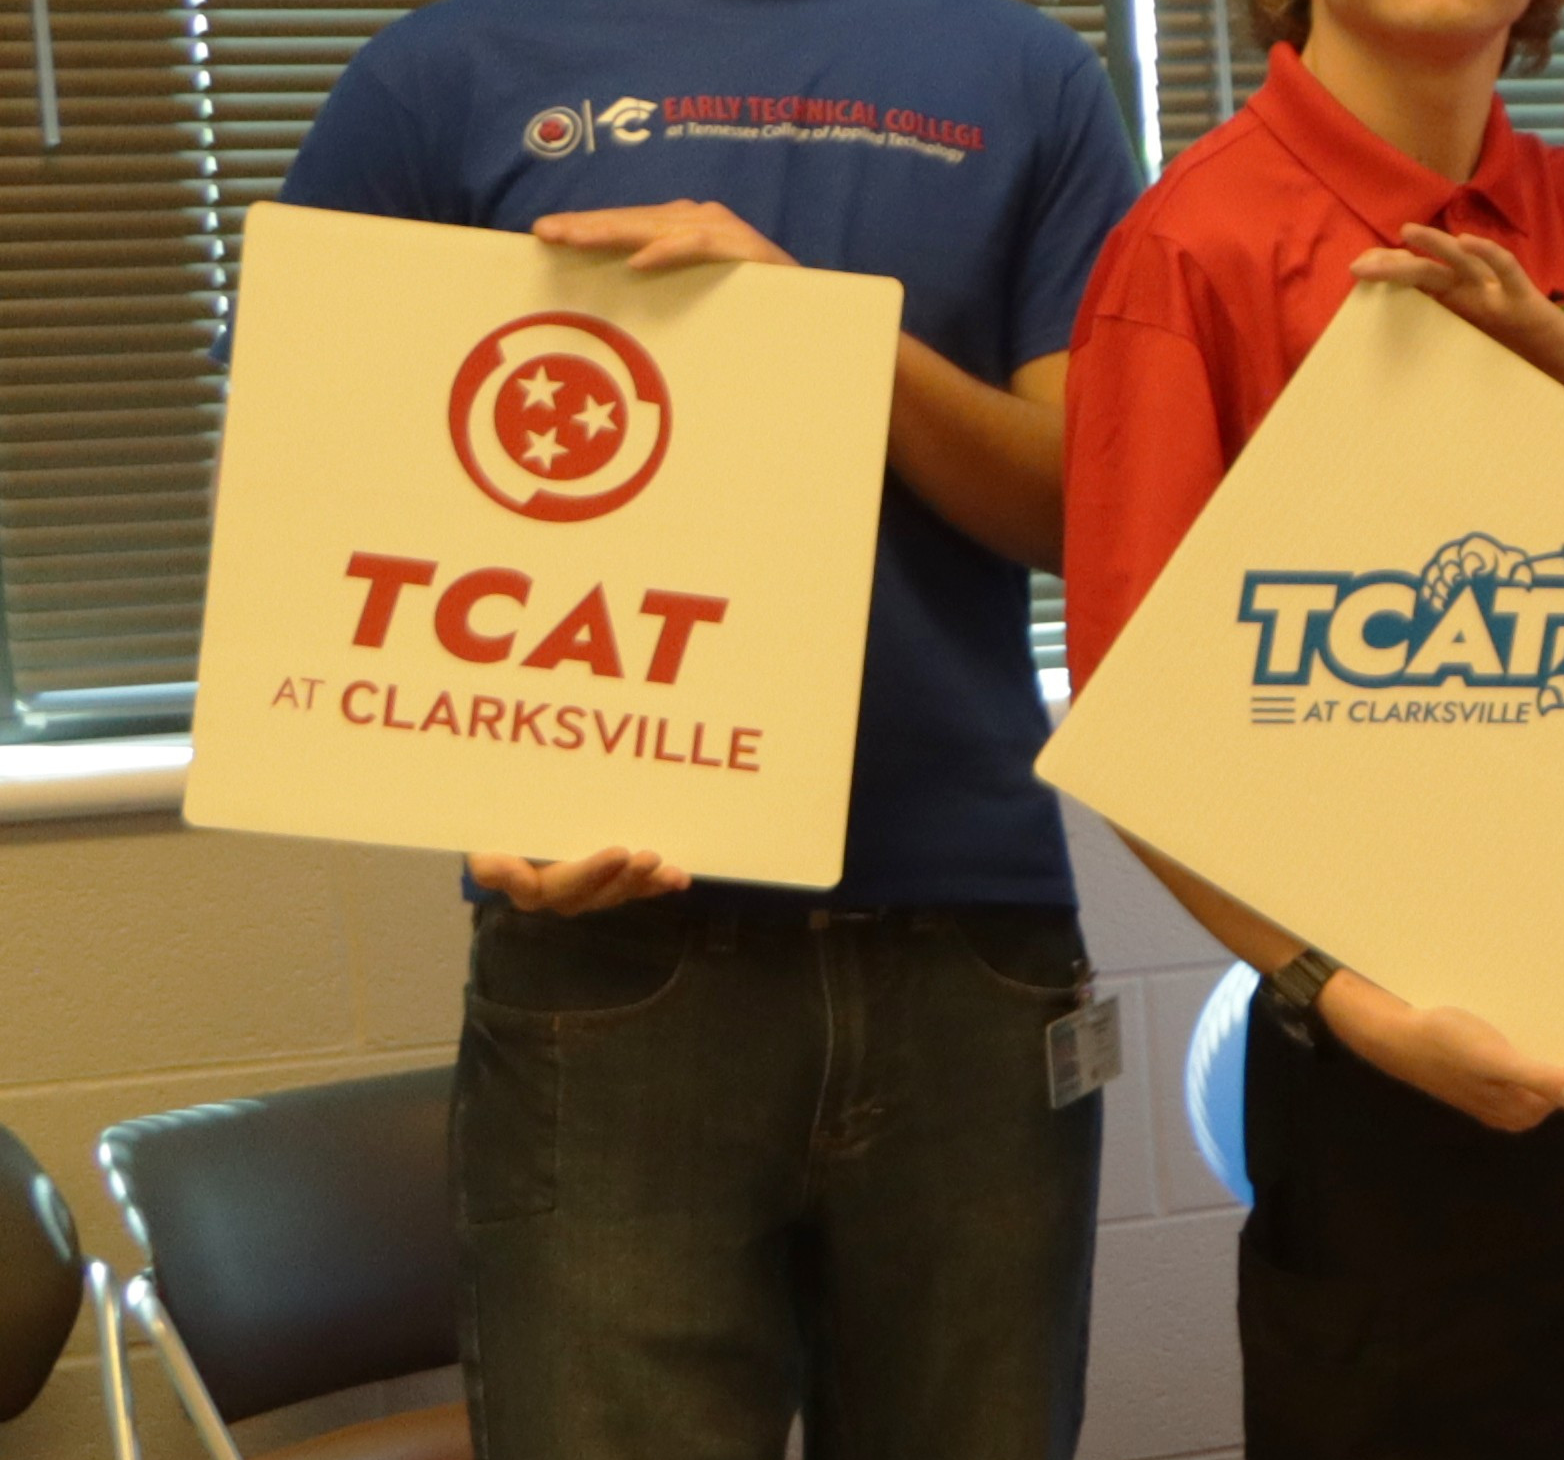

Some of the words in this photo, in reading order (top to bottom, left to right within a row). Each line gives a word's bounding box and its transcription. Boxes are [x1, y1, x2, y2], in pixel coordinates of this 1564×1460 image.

[662, 96, 742, 123] EARLY
[746, 94, 880, 129] TECHNICAL
[882, 107, 986, 151] COLLEGE
[686, 120, 760, 140] Tennessee
[344, 550, 730, 685] TCAT
[271, 676, 325, 711] AT
[339, 679, 764, 773] CLARKSVILLE
[1302, 700, 1338, 724] AT
[1347, 698, 1533, 725] CLARKSVILLE
